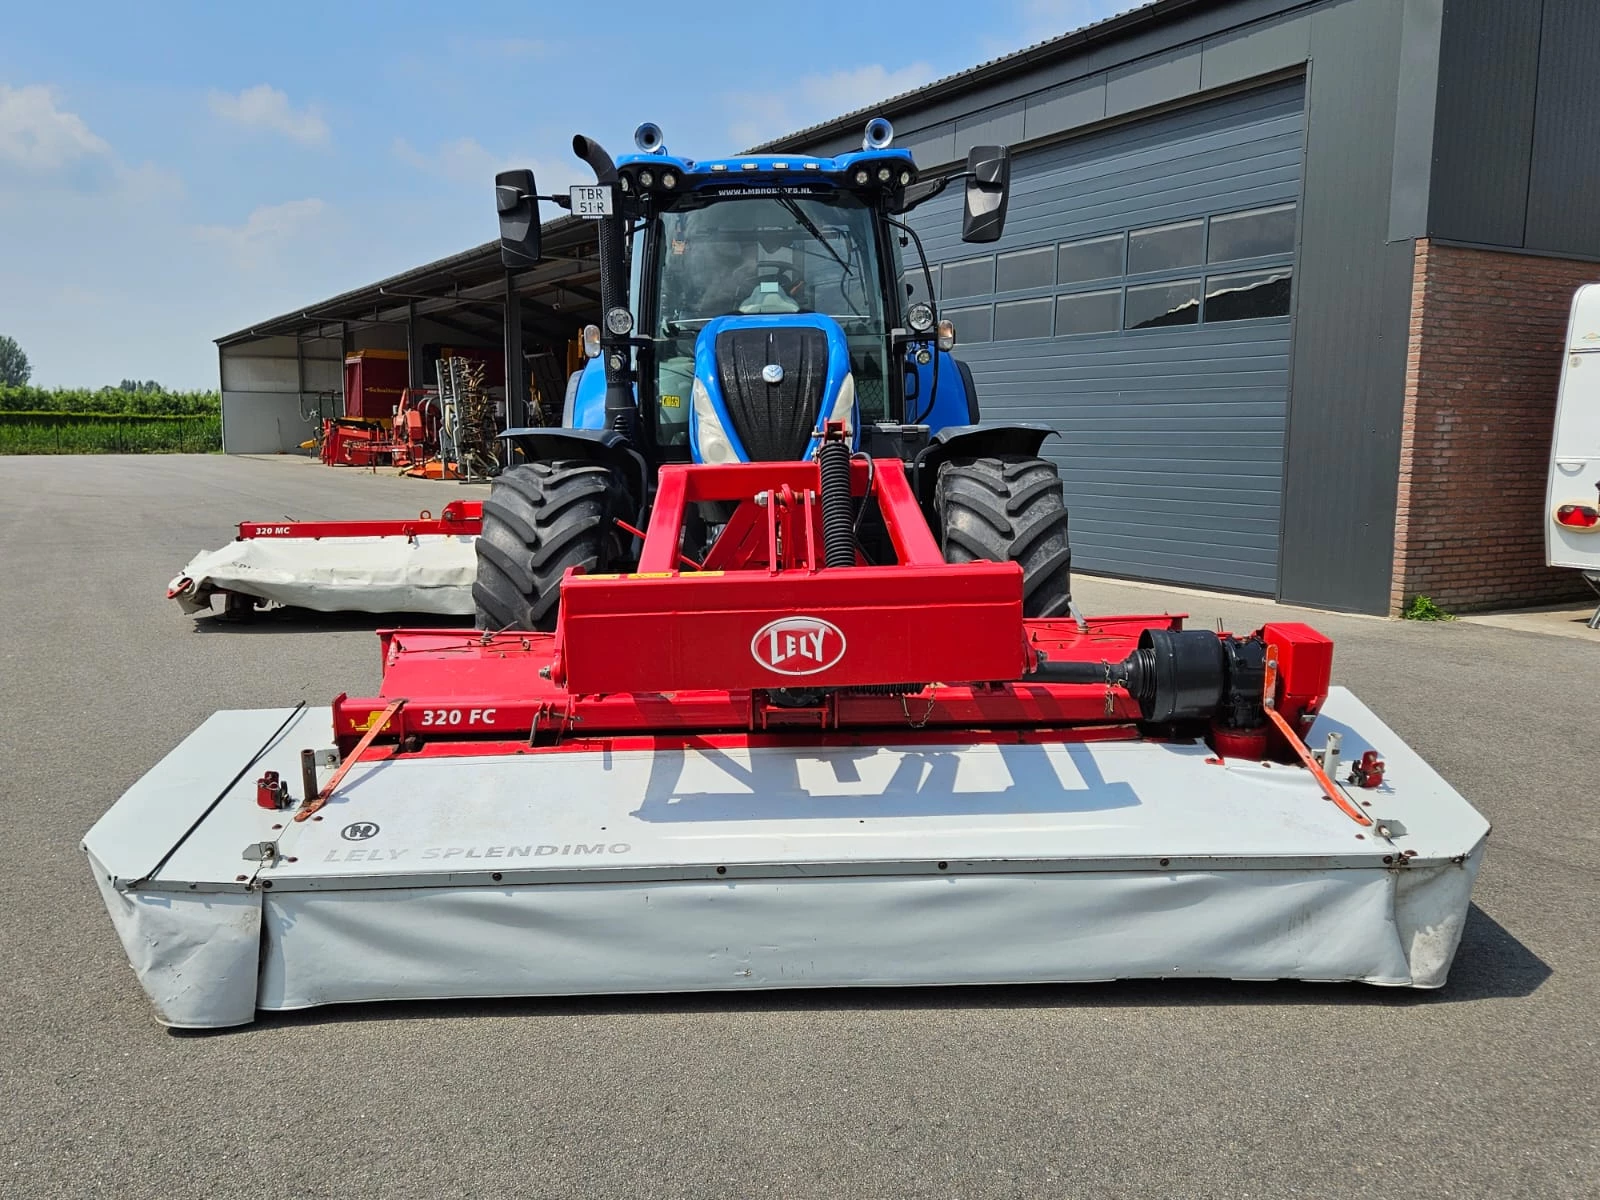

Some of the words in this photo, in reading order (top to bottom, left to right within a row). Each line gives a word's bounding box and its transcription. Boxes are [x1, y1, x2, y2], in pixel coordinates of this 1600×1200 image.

[579, 188, 603, 200] TBR
[770, 626, 826, 665] LELY
[421, 710, 462, 726] 320
[469, 709, 496, 724] FC
[323, 848, 409, 863] LELY
[421, 843, 631, 860] SPLENDIMO
